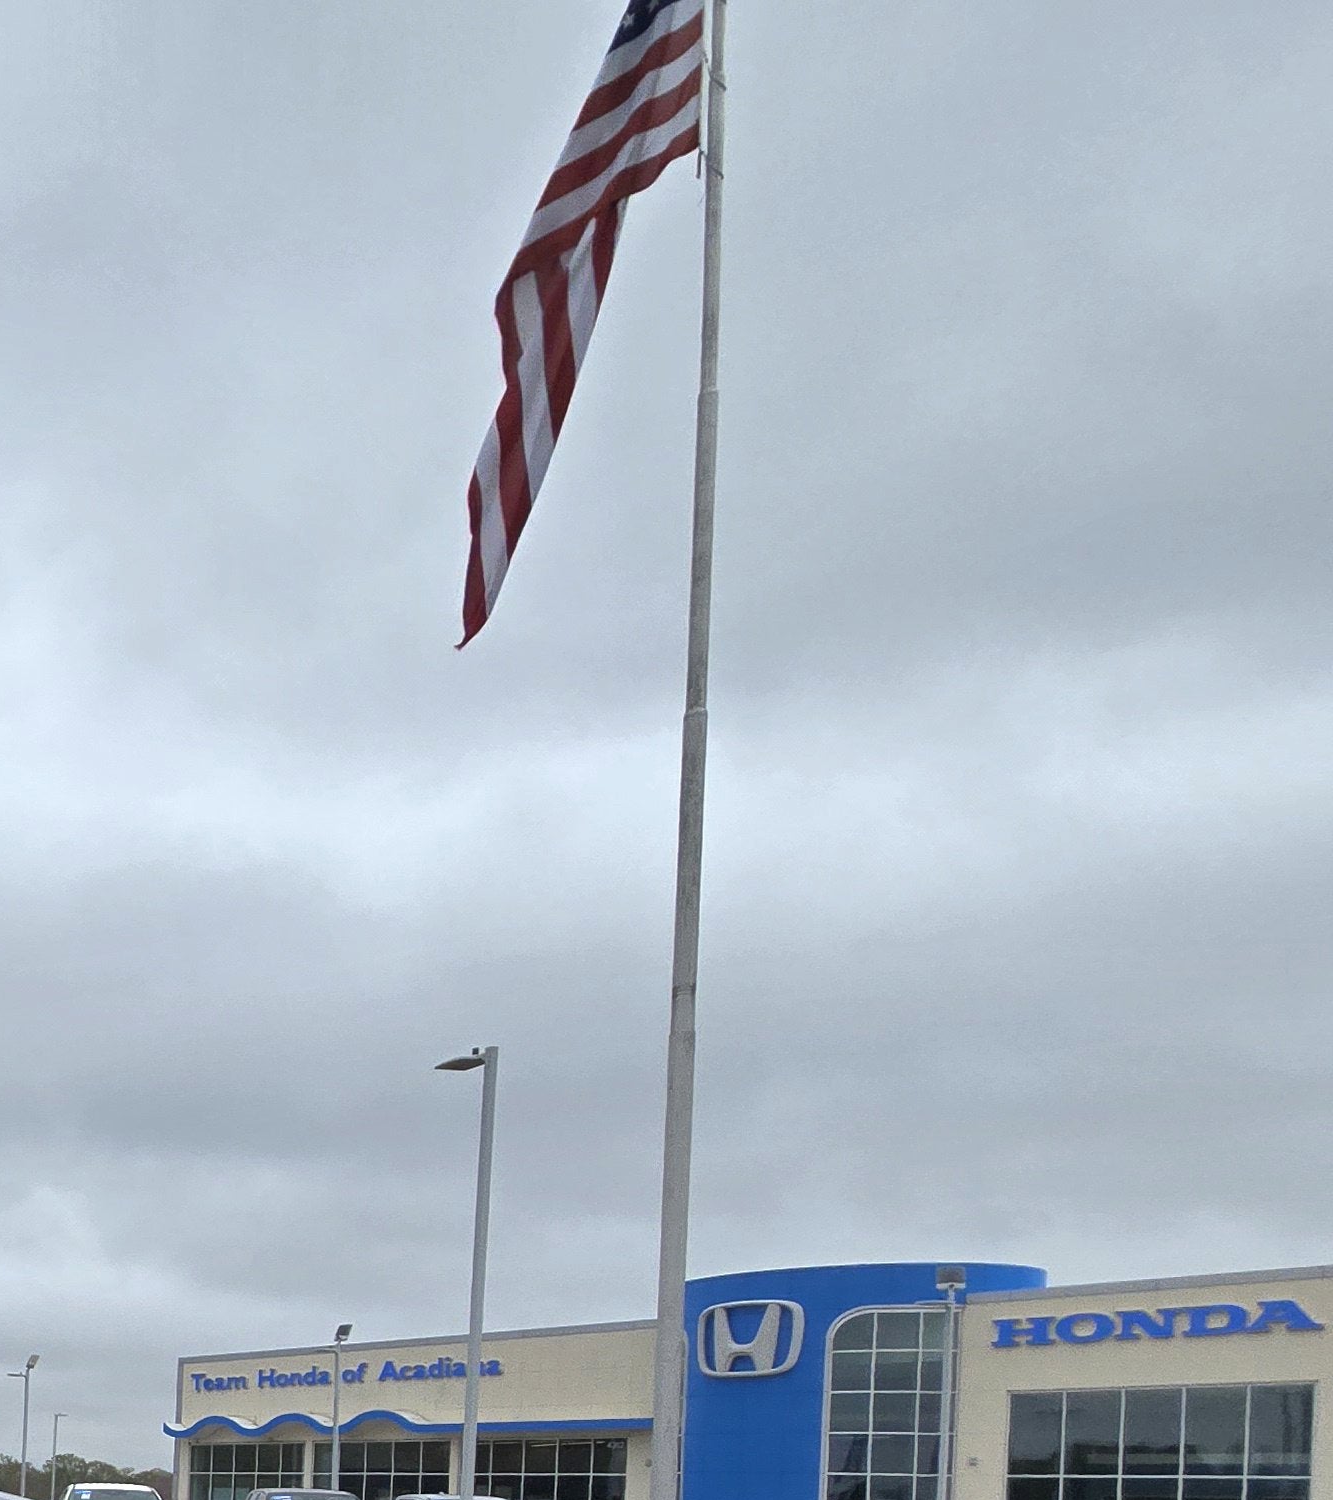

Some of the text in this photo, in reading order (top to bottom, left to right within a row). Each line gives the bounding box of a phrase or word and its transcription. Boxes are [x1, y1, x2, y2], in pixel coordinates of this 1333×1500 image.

[990, 1299, 1323, 1349] HONDA
[190, 1372, 248, 1393] Team
[256, 1365, 332, 1391] Honda
[341, 1362, 369, 1384] of
